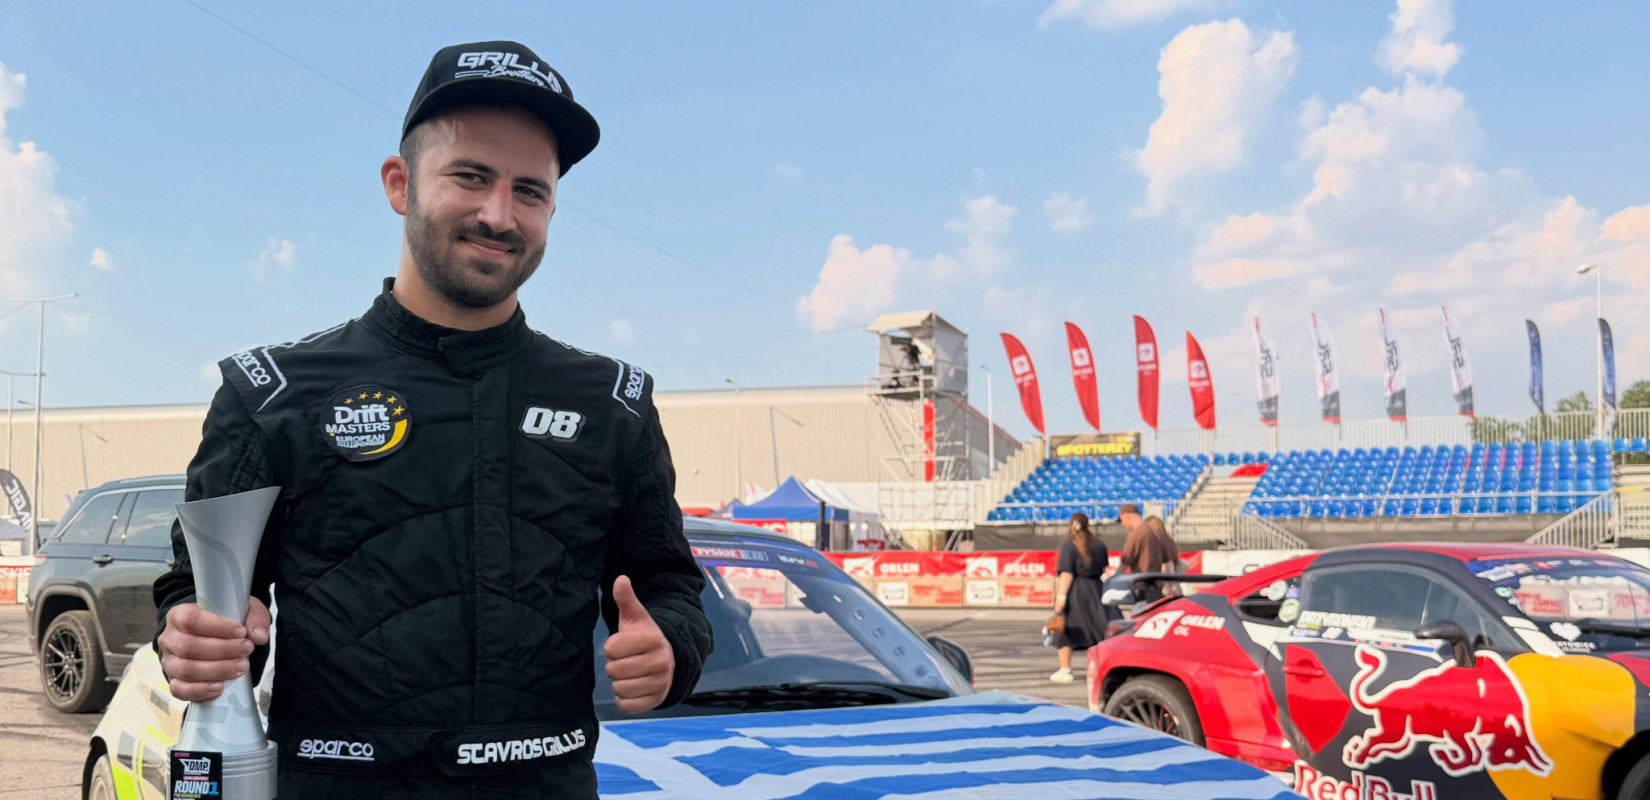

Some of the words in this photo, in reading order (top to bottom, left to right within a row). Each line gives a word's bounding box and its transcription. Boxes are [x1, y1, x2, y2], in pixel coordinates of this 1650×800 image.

[235, 350, 272, 387] parco
[334, 404, 390, 424] Drift
[521, 406, 582, 439] 08
[325, 421, 391, 434] MASTERS
[880, 562, 920, 573] ORLEN
[1180, 614, 1226, 631] ORLEN
[298, 739, 375, 760] sparco
[174, 780, 210, 795] ROUND
[208, 781, 219, 796] 1
